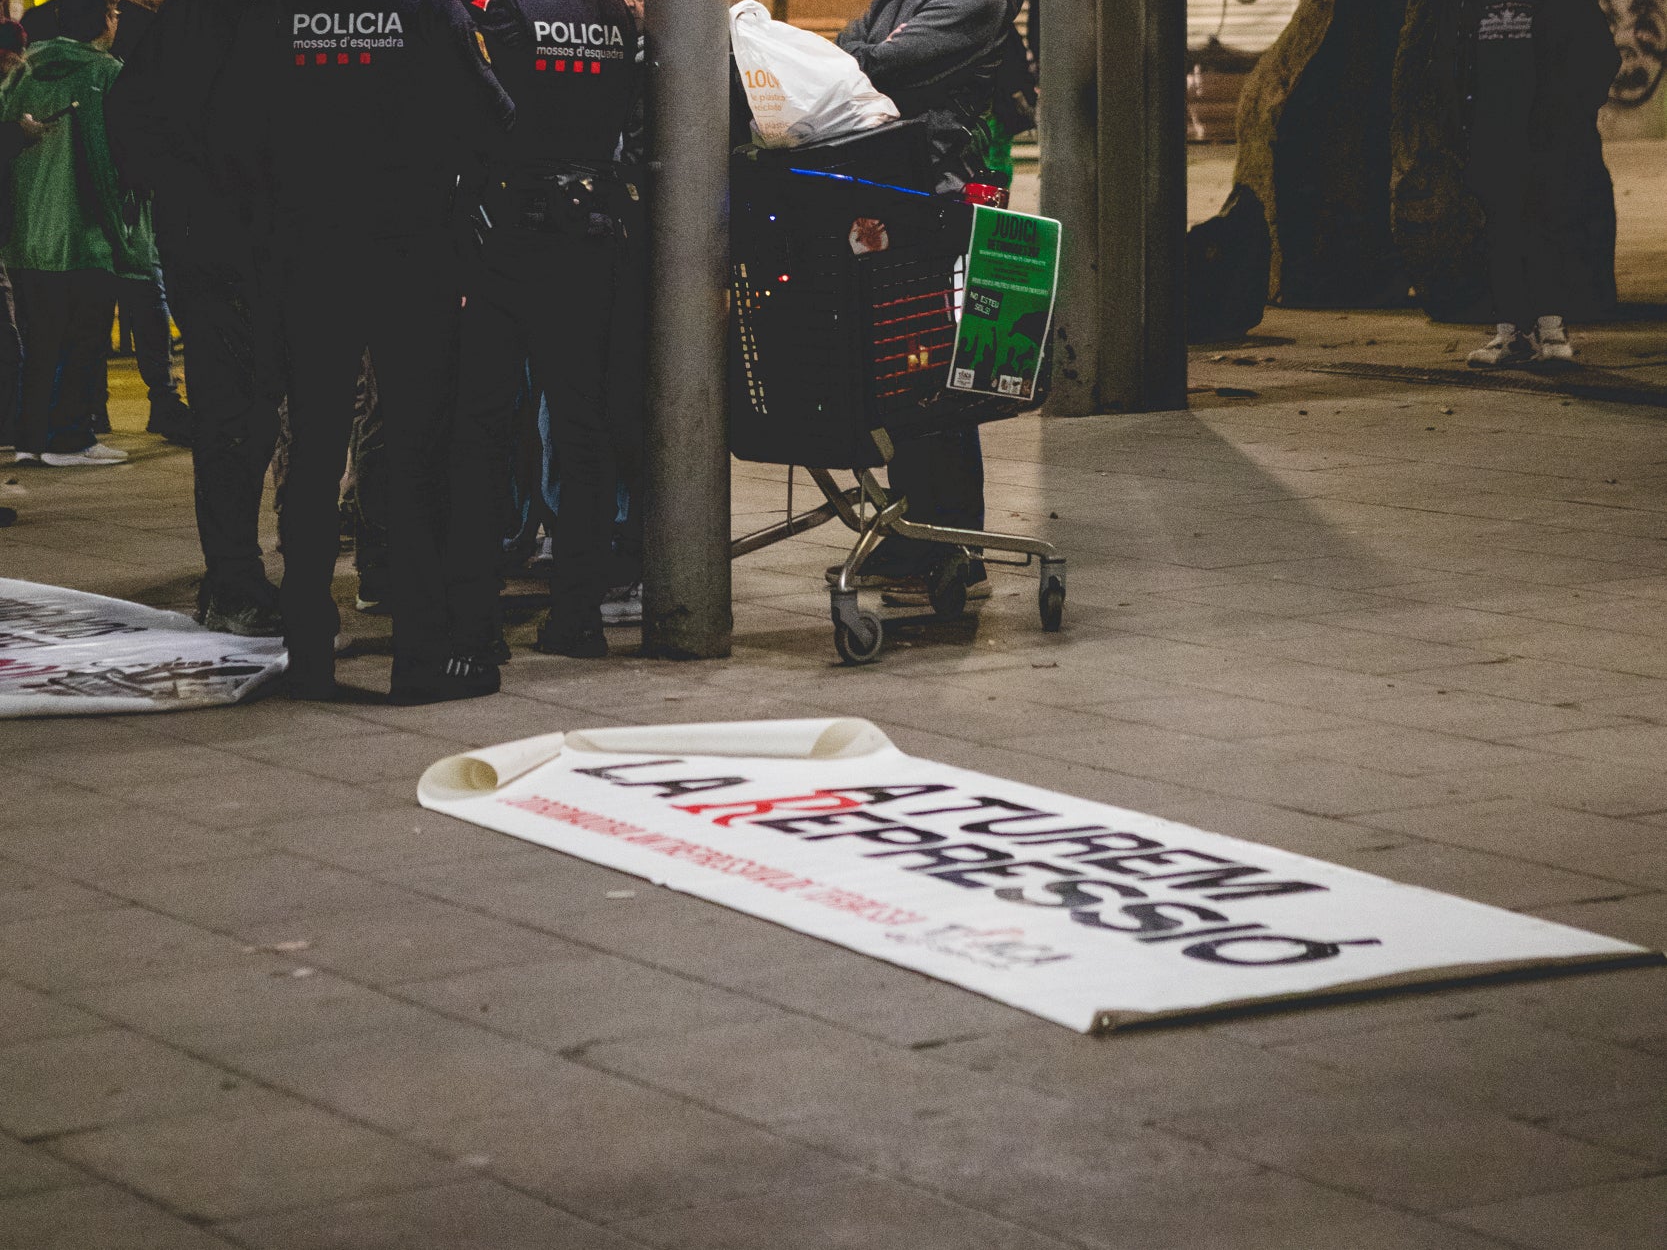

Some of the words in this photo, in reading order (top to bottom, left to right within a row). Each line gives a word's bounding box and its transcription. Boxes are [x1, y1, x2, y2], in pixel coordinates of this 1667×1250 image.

[293, 12, 404, 35] POLICIA
[534, 21, 624, 46] POLICIA
[293, 39, 337, 49] mossos
[340, 36, 404, 49] d'esquadra
[536, 46, 574, 57] mossos
[576, 46, 624, 59] d'esquadra
[992, 213, 1038, 244] JUDICI
[824, 783, 1330, 901] ATUREM
[572, 760, 752, 799] LA
[670, 789, 1383, 967] REPRESSIÓ
